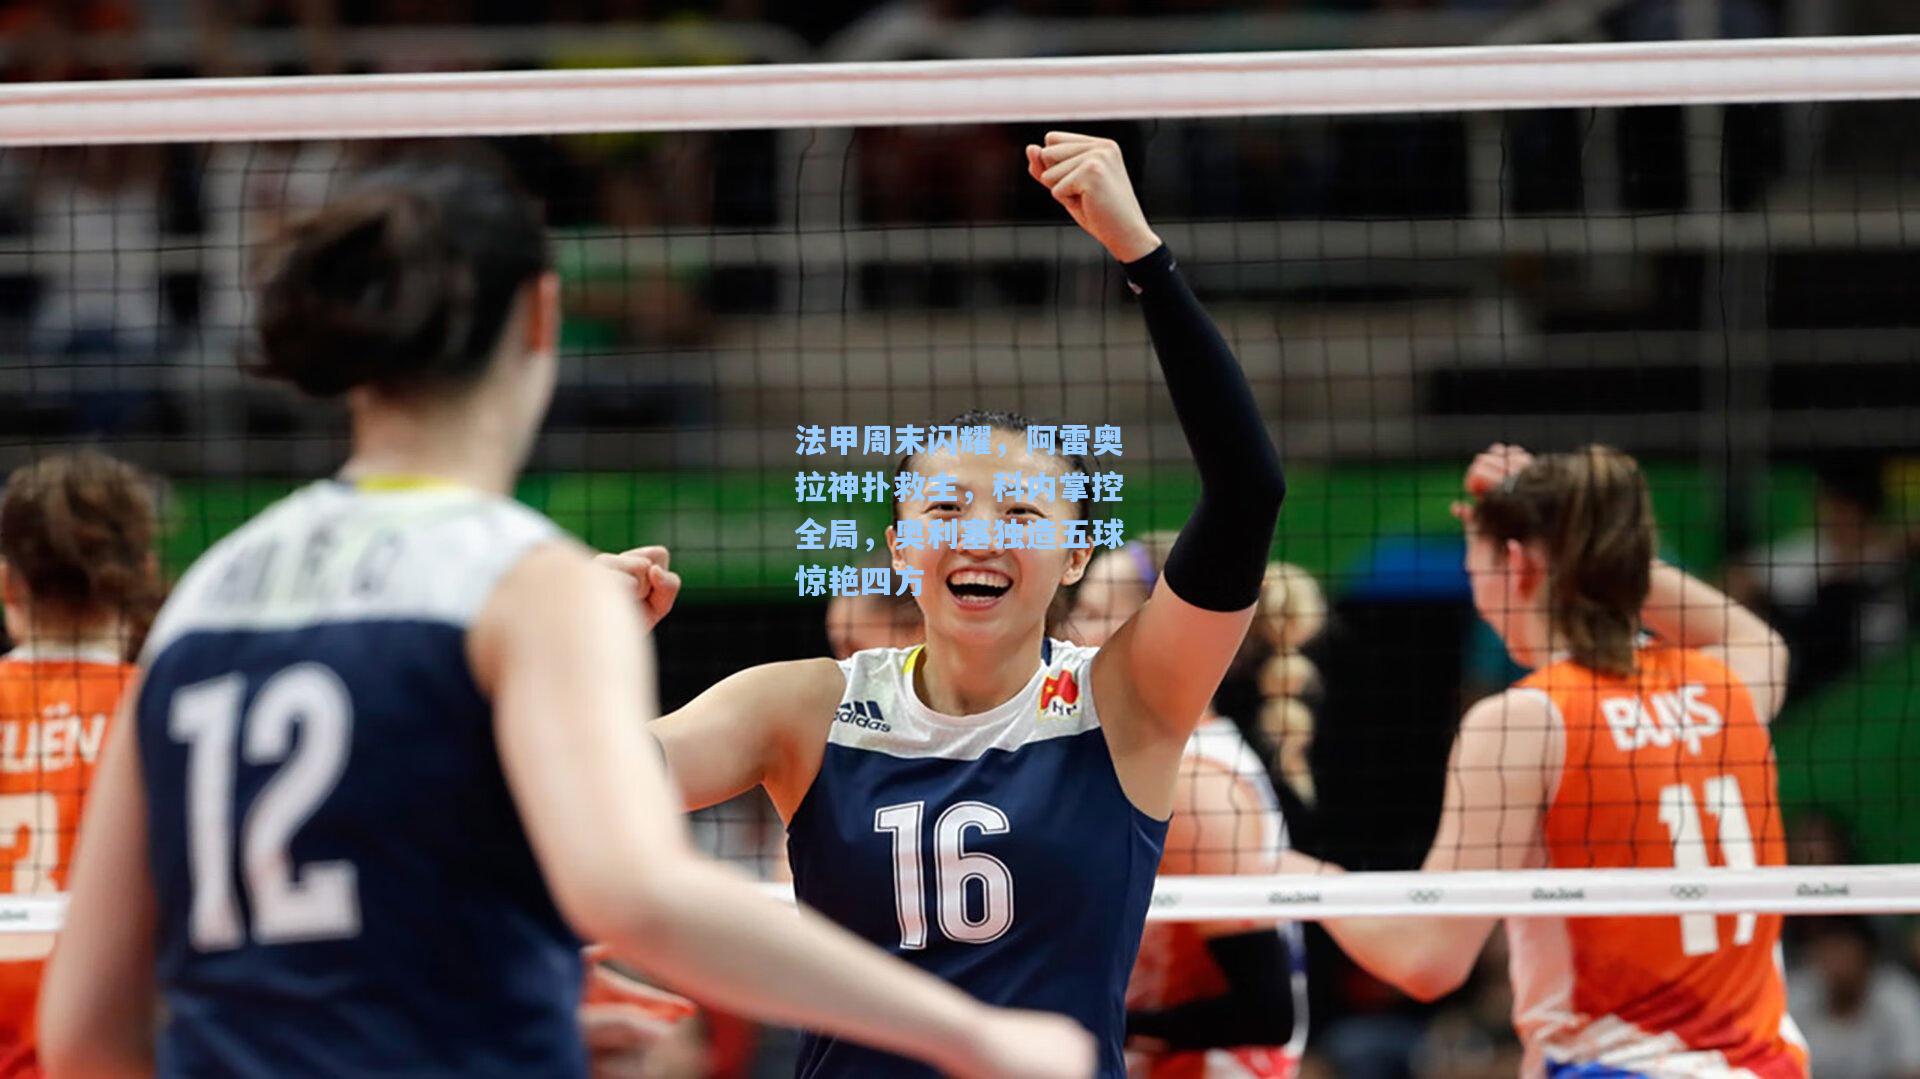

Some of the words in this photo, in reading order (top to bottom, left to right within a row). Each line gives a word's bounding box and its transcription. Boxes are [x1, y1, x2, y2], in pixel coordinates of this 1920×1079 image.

[168, 662, 364, 952] 12
[874, 801, 1014, 949] 16
[1658, 774, 1758, 956] 11
